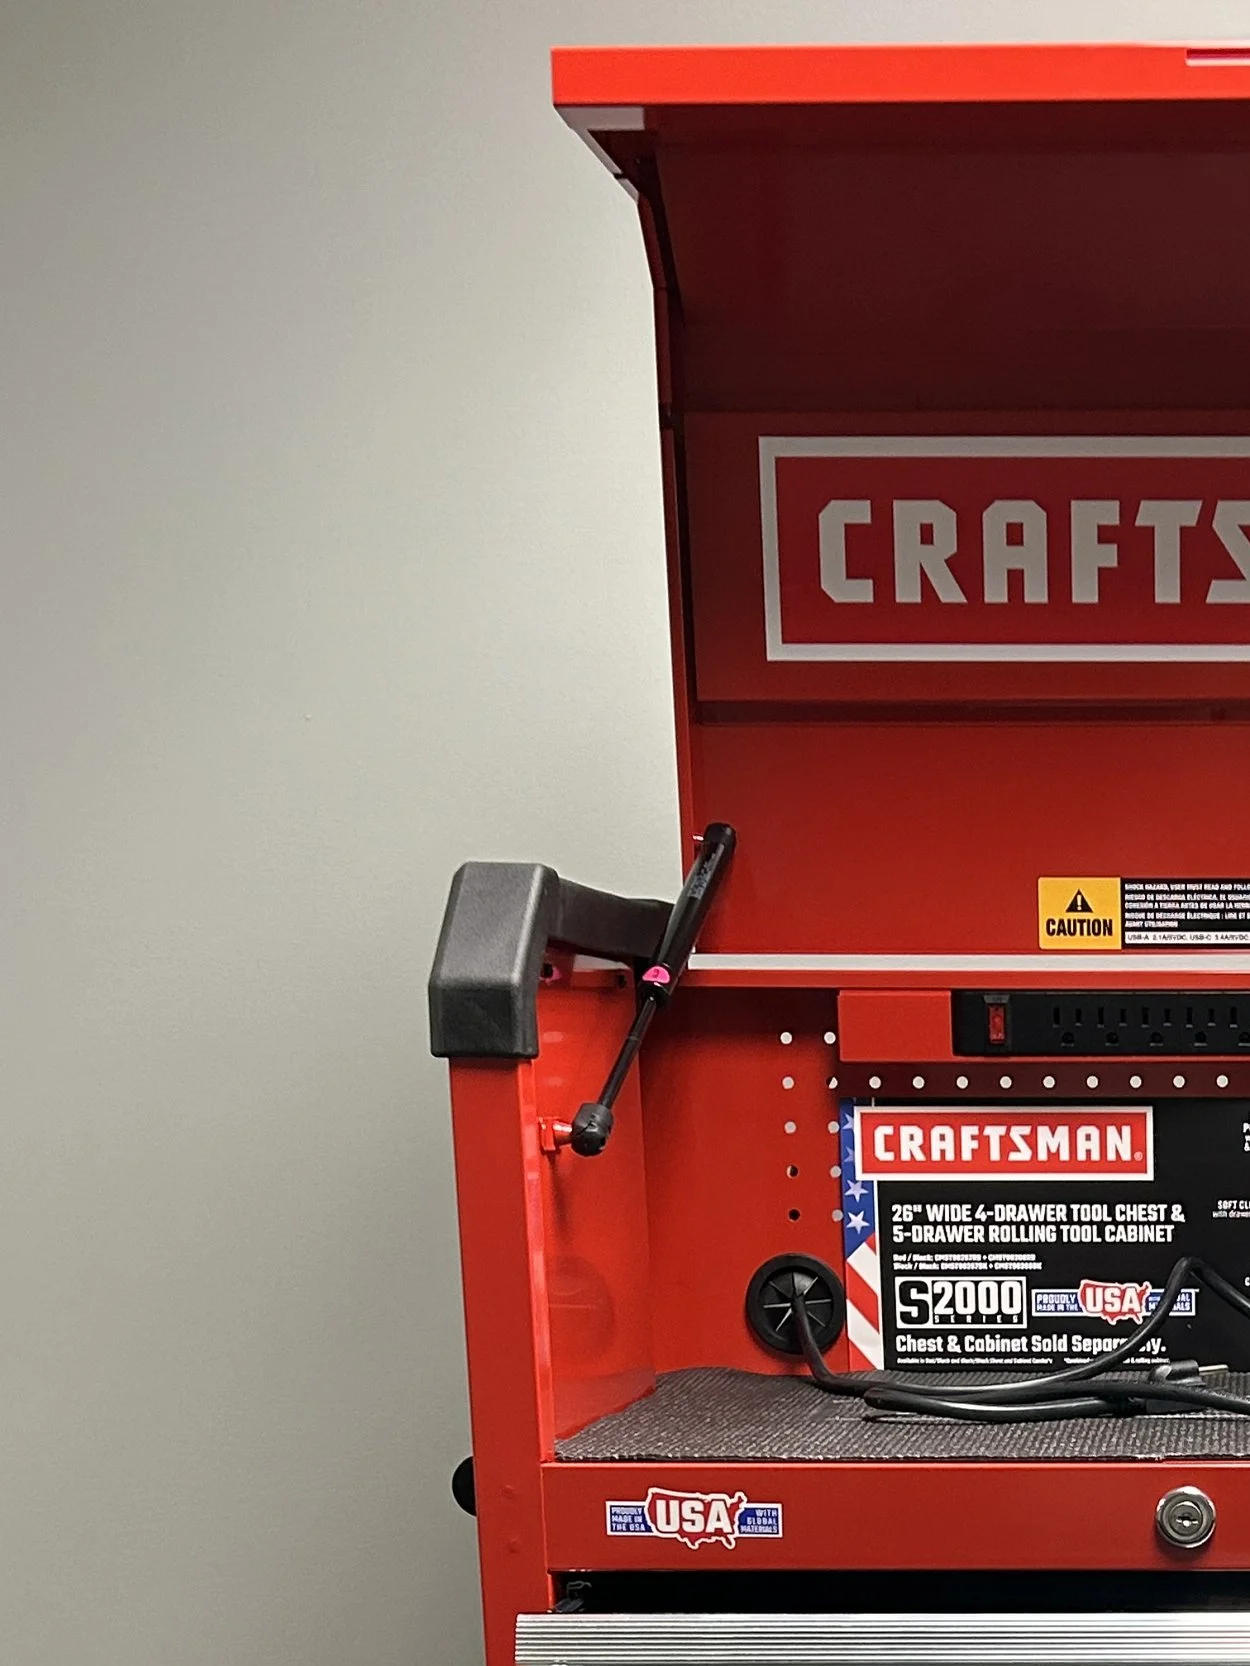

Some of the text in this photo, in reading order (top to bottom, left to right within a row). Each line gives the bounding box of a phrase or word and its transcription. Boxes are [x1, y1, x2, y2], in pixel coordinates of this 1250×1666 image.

[1045, 917, 1113, 937] CAUTION
[873, 1125, 1131, 1161] CRAFTSMAN
[1244, 1142, 1250, 1152] &
[926, 1205, 972, 1222] WIDE
[975, 1205, 1067, 1222] 4-DRAWER
[1071, 1205, 1112, 1222] TOOL
[1115, 1205, 1167, 1222] CHEST
[1171, 1206, 1186, 1222] &
[1217, 1200, 1238, 1210] SOFT
[892, 1225, 1175, 1243] 5-DRAWER ROLLING TOOL CABINET
[1037, 1294, 1075, 1303] PROUDLY
[1085, 1287, 1142, 1313] USA
[934, 1315, 1019, 1323] SERIES
[896, 1334, 943, 1352] Chest
[947, 1335, 961, 1353] &
[964, 1334, 1027, 1352] Cabinet
[1031, 1334, 1067, 1352] Sold
[611, 1507, 642, 1515] PROUDLY
[655, 1499, 733, 1533] USA
[755, 1509, 777, 1517] WITH
